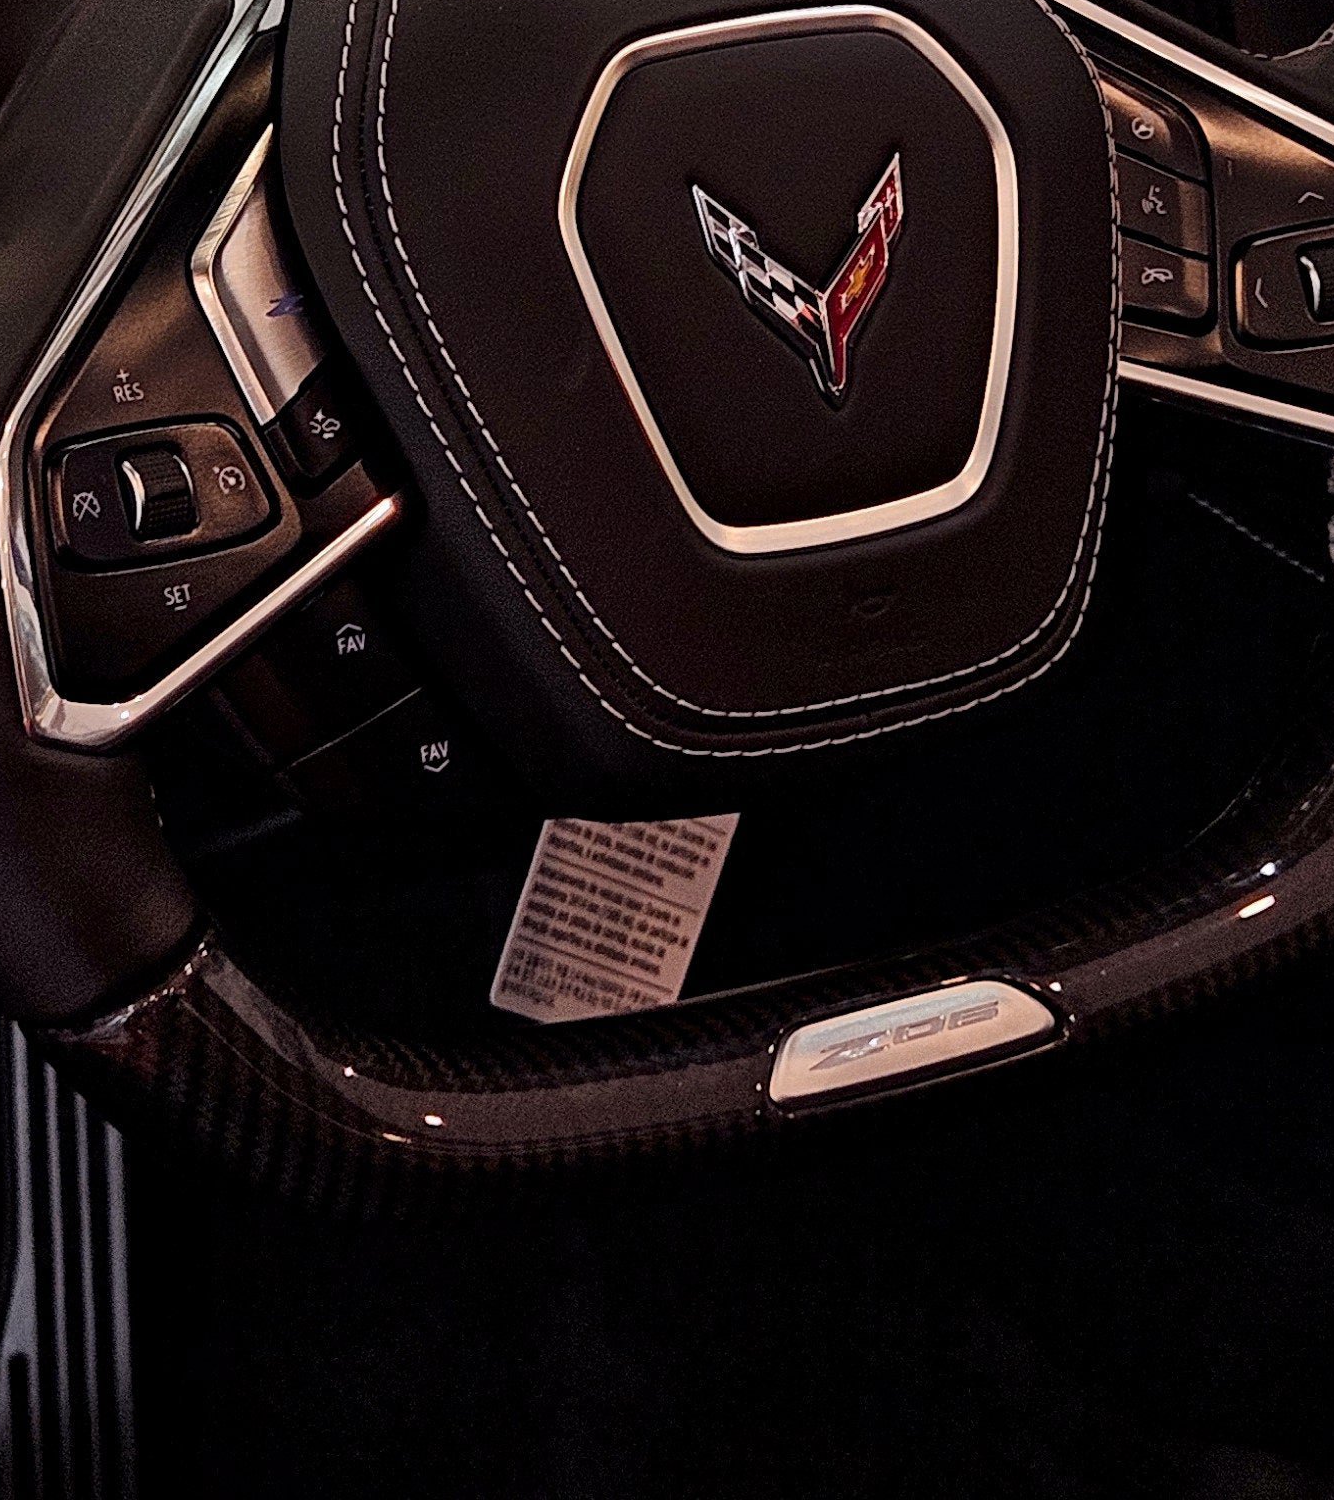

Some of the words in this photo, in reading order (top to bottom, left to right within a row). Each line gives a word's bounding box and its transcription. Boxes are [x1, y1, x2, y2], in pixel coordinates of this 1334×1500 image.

[111, 381, 145, 404] RES
[164, 583, 191, 606] SET
[336, 631, 367, 654] FAV
[420, 741, 449, 763] FAV
